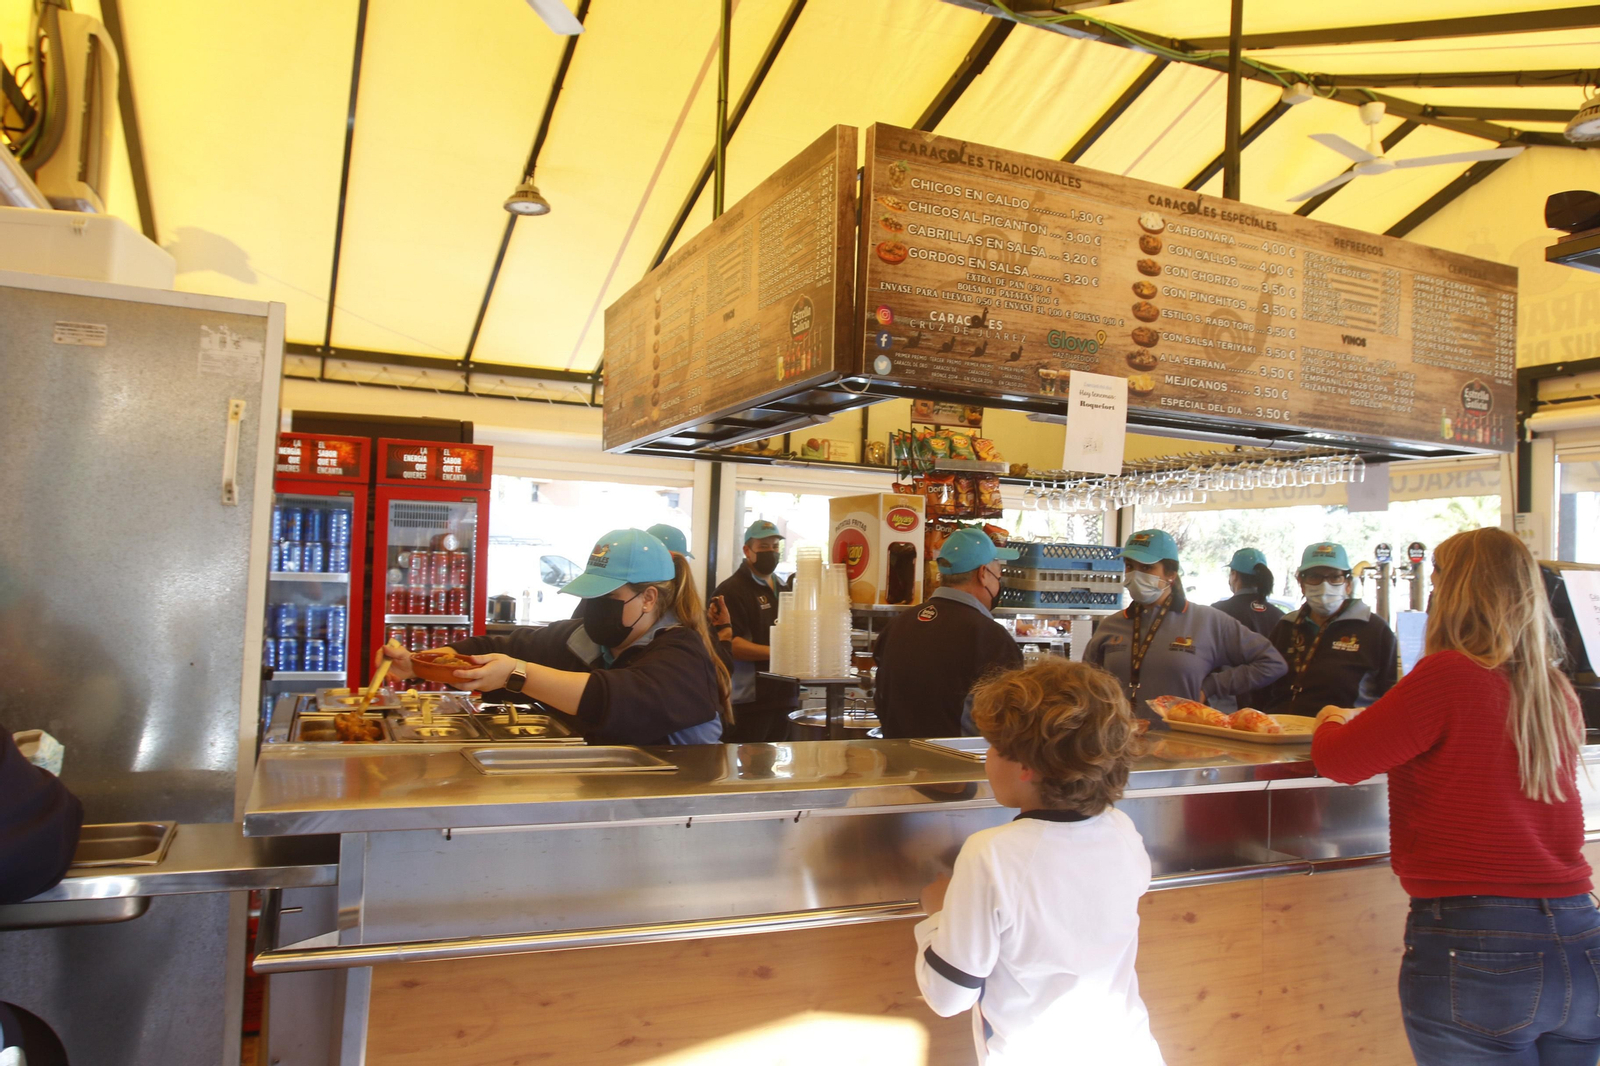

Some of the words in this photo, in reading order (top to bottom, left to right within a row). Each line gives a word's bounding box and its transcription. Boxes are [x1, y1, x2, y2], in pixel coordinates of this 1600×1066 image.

[898, 140, 984, 168] CARACOLES
[988, 160, 1082, 188] TRADICIONALES
[911, 178, 962, 197] CHICOS
[965, 189, 983, 201] EN
[986, 192, 1029, 210] CALDO
[1070, 210, 1094, 223] 1,30
[1096, 215, 1104, 225] €
[1148, 194, 1216, 218] CARACOLES
[1221, 210, 1278, 231] ESPECIALES
[908, 201, 960, 219] CHICOS
[962, 212, 979, 223] AL
[983, 215, 1047, 236] PICANTON
[1066, 232, 1091, 244] 3,00
[1094, 236, 1101, 246] €
[908, 224, 983, 246] CABRILLAS
[986, 238, 1004, 250] EN
[1007, 241, 1046, 258] SALSA
[1062, 252, 1088, 264] 3,20
[1091, 257, 1098, 266] €
[1167, 222, 1236, 245] CARBONARA
[1261, 241, 1286, 256] 4,00
[1289, 248, 1296, 258] €
[1334, 238, 1384, 256] REFRESCOS
[908, 247, 965, 266] GORDOS
[968, 258, 986, 270] EN
[989, 261, 1029, 276] SALSA
[1064, 274, 1088, 286] 3,20
[1092, 278, 1099, 287] €
[1168, 244, 1192, 257] CON
[1195, 250, 1237, 266] CALLOS
[1286, 268, 1294, 278] €
[966, 273, 992, 284] EXTRA
[996, 278, 1006, 286] DE
[1010, 280, 1024, 290] PAN
[1028, 284, 1044, 293] 0,30
[1046, 286, 1052, 294] €
[1164, 265, 1188, 278] CON
[1191, 270, 1239, 288] CHORIZO
[1289, 288, 1296, 298] €
[1304, 269, 1328, 279] FANTA
[1414, 274, 1434, 283] JARRA
[1446, 281, 1475, 293] CERVEZA
[958, 282, 982, 294] BOLSA
[986, 287, 996, 296] DE
[1000, 289, 1034, 303] PATATAS
[1036, 296, 1051, 304] 1,00
[1054, 298, 1059, 306] €
[1162, 286, 1186, 299] CON
[1190, 291, 1247, 310] PINCHITOS
[1262, 303, 1286, 317] 3,50
[1289, 308, 1296, 319] €
[880, 282, 912, 294] ENVASE
[916, 287, 938, 298] PARA
[942, 291, 973, 303] LLEVAR
[976, 296, 992, 306] 0,50
[995, 299, 1001, 307] €
[1004, 300, 1033, 313] ENVASE
[1048, 308, 1063, 317] 1,00
[1065, 310, 1071, 318] €
[1074, 312, 1100, 323] BOLSAS
[1119, 319, 1124, 327] €
[910, 319, 945, 332] CRUZ
[954, 326, 969, 335] DE
[978, 329, 1026, 343] JUAREZ
[1161, 309, 1193, 322] ESTILO
[1206, 317, 1230, 328] RABO
[1233, 322, 1255, 333] TORO
[1266, 326, 1286, 338] 3,50
[1289, 329, 1296, 339] €
[1047, 330, 1099, 354] Glovo
[1162, 332, 1182, 343] CON
[1184, 335, 1214, 348] SALSA
[1217, 341, 1256, 354] TERIYAKI
[1266, 347, 1287, 359] 3,50
[1289, 350, 1296, 360] €
[1342, 334, 1366, 347] VINOS
[1072, 354, 1095, 363] PEDIDO
[1301, 346, 1323, 357] TINTO
[1338, 354, 1367, 363] VERANO
[1160, 354, 1166, 362] A
[1170, 355, 1181, 364] LA
[1184, 357, 1226, 371] SERRANA
[1260, 366, 1285, 379] 3,50
[1287, 370, 1294, 380] €
[1301, 356, 1319, 365] FINO
[1321, 360, 1340, 368] COPA
[1366, 367, 1388, 376] MEDIO
[1301, 365, 1335, 376] VERDEJO
[1362, 374, 1381, 382] COPA
[1165, 375, 1228, 391] MEJICANOS
[1282, 390, 1288, 400] €
[1300, 382, 1337, 394] FRIZANTE
[1373, 392, 1392, 401] COPA
[1301, 373, 1352, 387] TEMPRANILLO
[1369, 384, 1388, 392] COPA
[1350, 398, 1382, 409] BOTELLA
[1464, 388, 1489, 400] Estrella
[1080, 400, 1115, 410] Roquefort
[1161, 397, 1205, 410] ESPECIAL
[1208, 404, 1226, 412] DEL
[1228, 406, 1242, 415] DIA
[1283, 411, 1290, 421] €
[293, 440, 301, 448] LA
[288, 456, 300, 464] QUE
[317, 458, 328, 466] QUE
[318, 450, 338, 458] SABOR
[443, 457, 462, 465] SABOR
[317, 466, 343, 475] ENCANTA
[403, 471, 426, 479] QUIERES
[415, 463, 427, 471] QUE
[442, 473, 467, 481] ENCANTA
